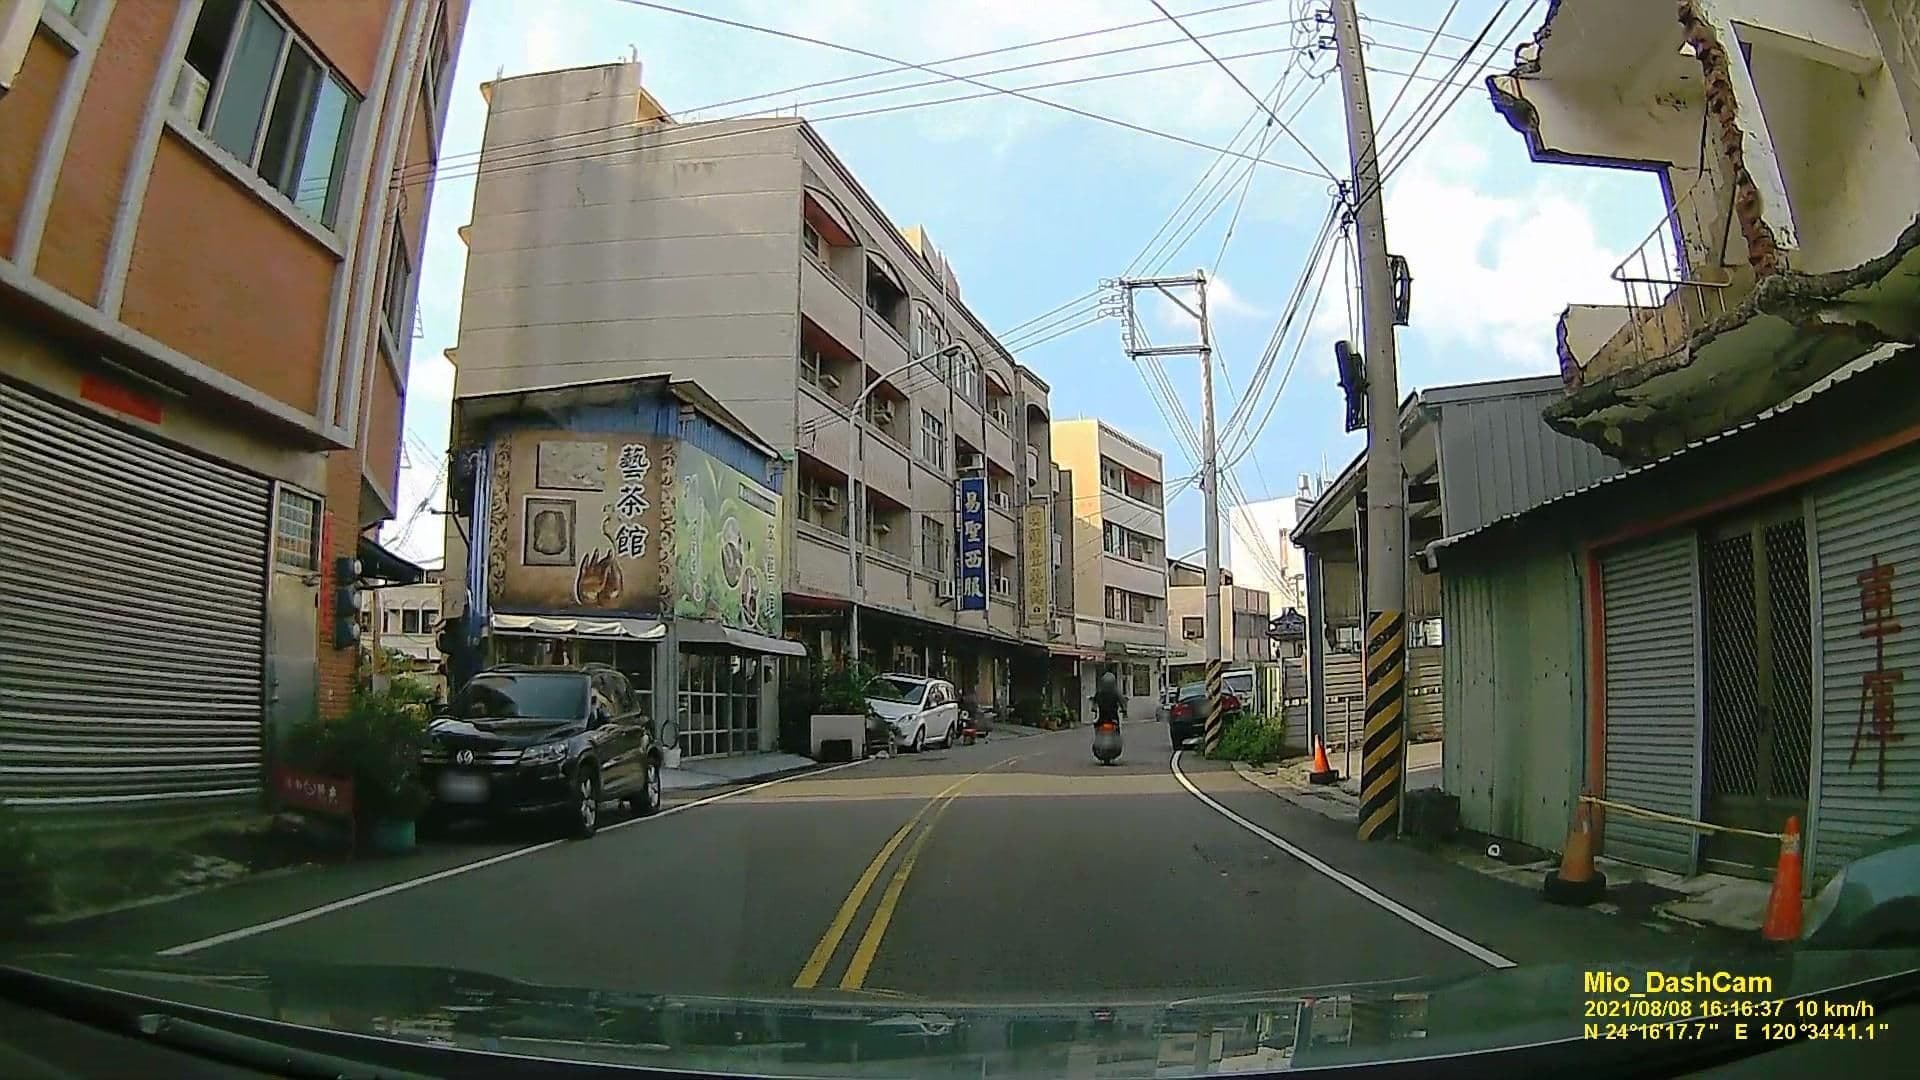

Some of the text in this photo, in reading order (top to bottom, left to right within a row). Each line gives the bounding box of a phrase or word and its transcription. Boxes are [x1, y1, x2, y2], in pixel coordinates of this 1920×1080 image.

[617, 444, 651, 558] 藝茶館
[964, 491, 983, 597] 易聖西服
[1849, 554, 1905, 791] 車庫
